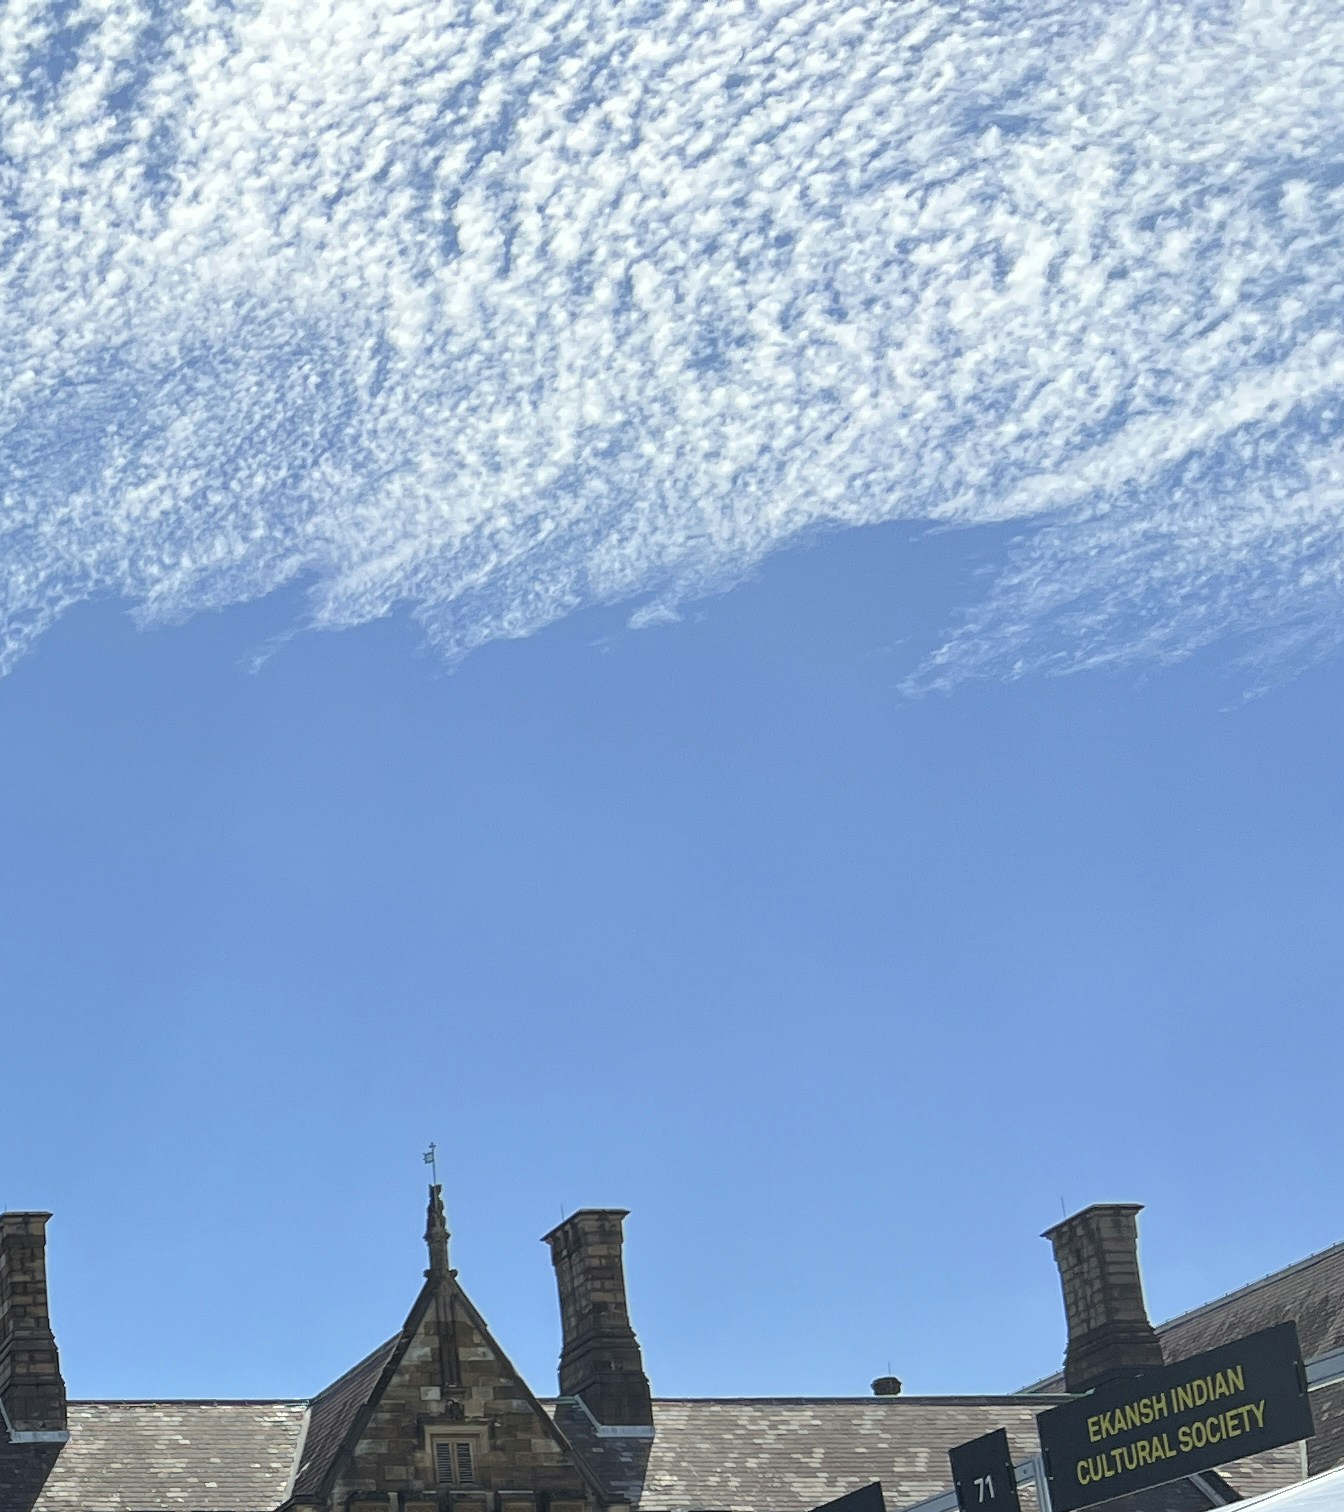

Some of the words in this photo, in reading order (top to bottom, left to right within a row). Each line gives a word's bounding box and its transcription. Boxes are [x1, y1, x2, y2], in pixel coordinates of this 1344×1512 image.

[1076, 1434, 1176, 1485] CULTURAL
[1178, 1400, 1265, 1452] SOCIETY
[1087, 1393, 1168, 1443] EKANSH
[1171, 1365, 1245, 1413] INDIAN
[974, 1475, 994, 1503] 71
